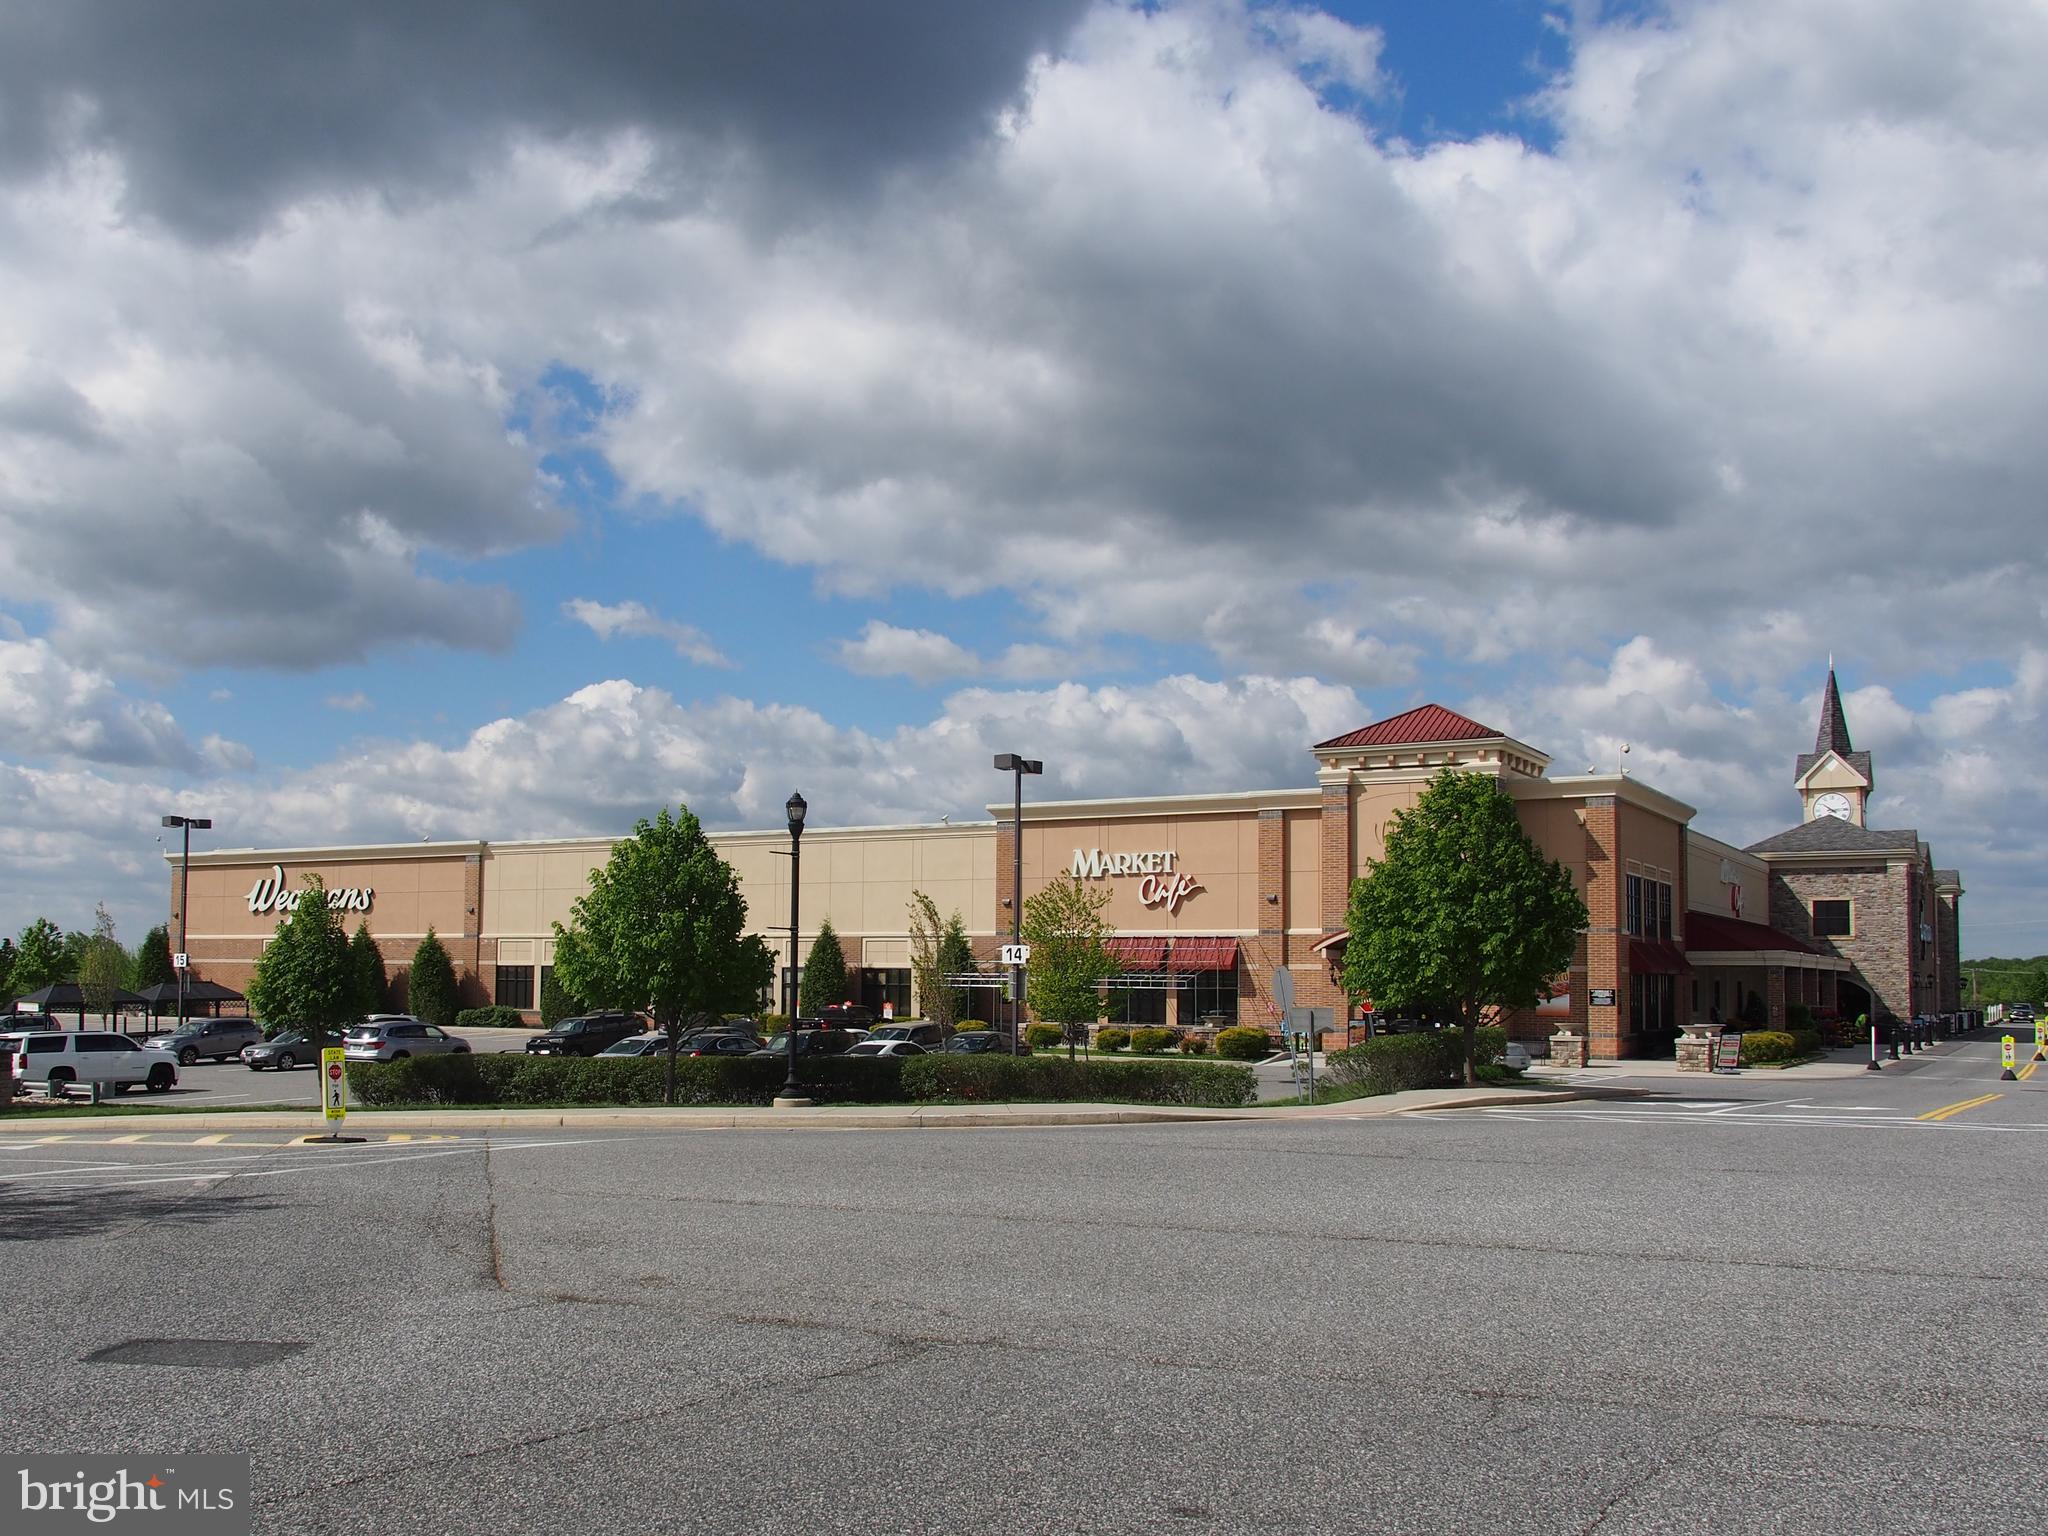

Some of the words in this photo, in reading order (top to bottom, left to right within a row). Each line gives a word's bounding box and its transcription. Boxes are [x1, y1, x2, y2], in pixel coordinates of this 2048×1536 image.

[1071, 848, 1176, 878] MARKET
[243, 864, 373, 925] Wegans
[1138, 872, 1204, 912] Café
[175, 955, 185, 965] 15
[1006, 947, 1022, 961] 14
